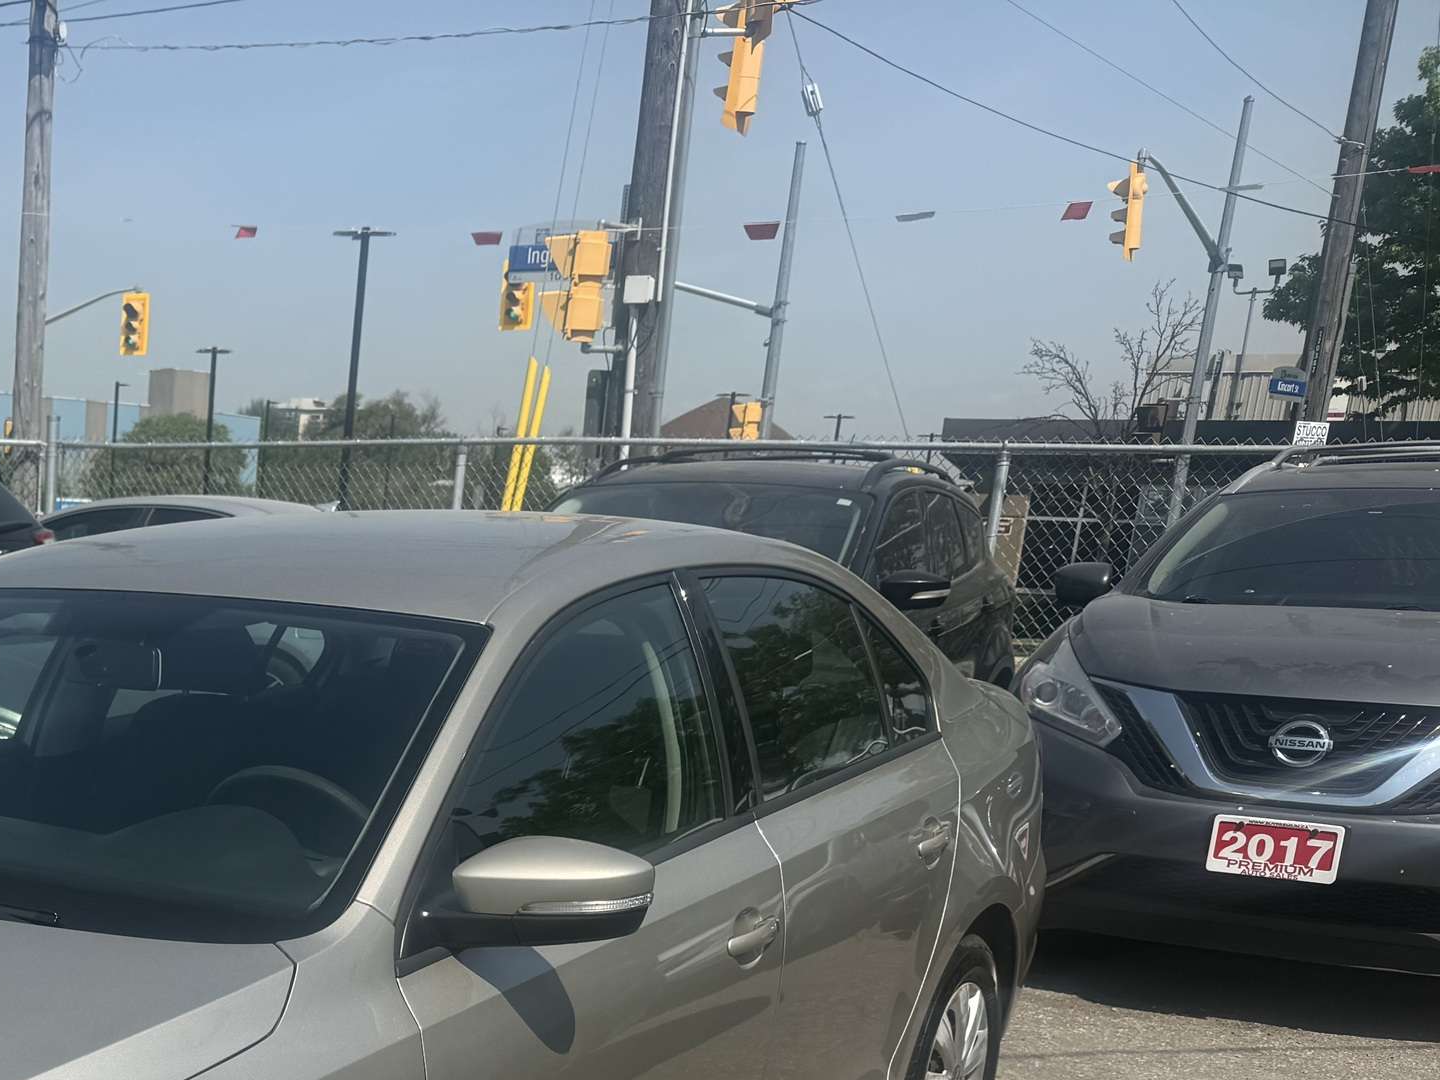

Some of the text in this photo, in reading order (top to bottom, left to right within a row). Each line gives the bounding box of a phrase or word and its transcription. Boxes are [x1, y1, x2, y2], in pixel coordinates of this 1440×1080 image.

[1296, 425, 1327, 437] STUCCO
[1274, 738, 1326, 749] NISSAN
[1218, 831, 1334, 868] 2017
[1227, 859, 1315, 877] PREMIUM
[1241, 869, 1299, 880] AUTO SALES
